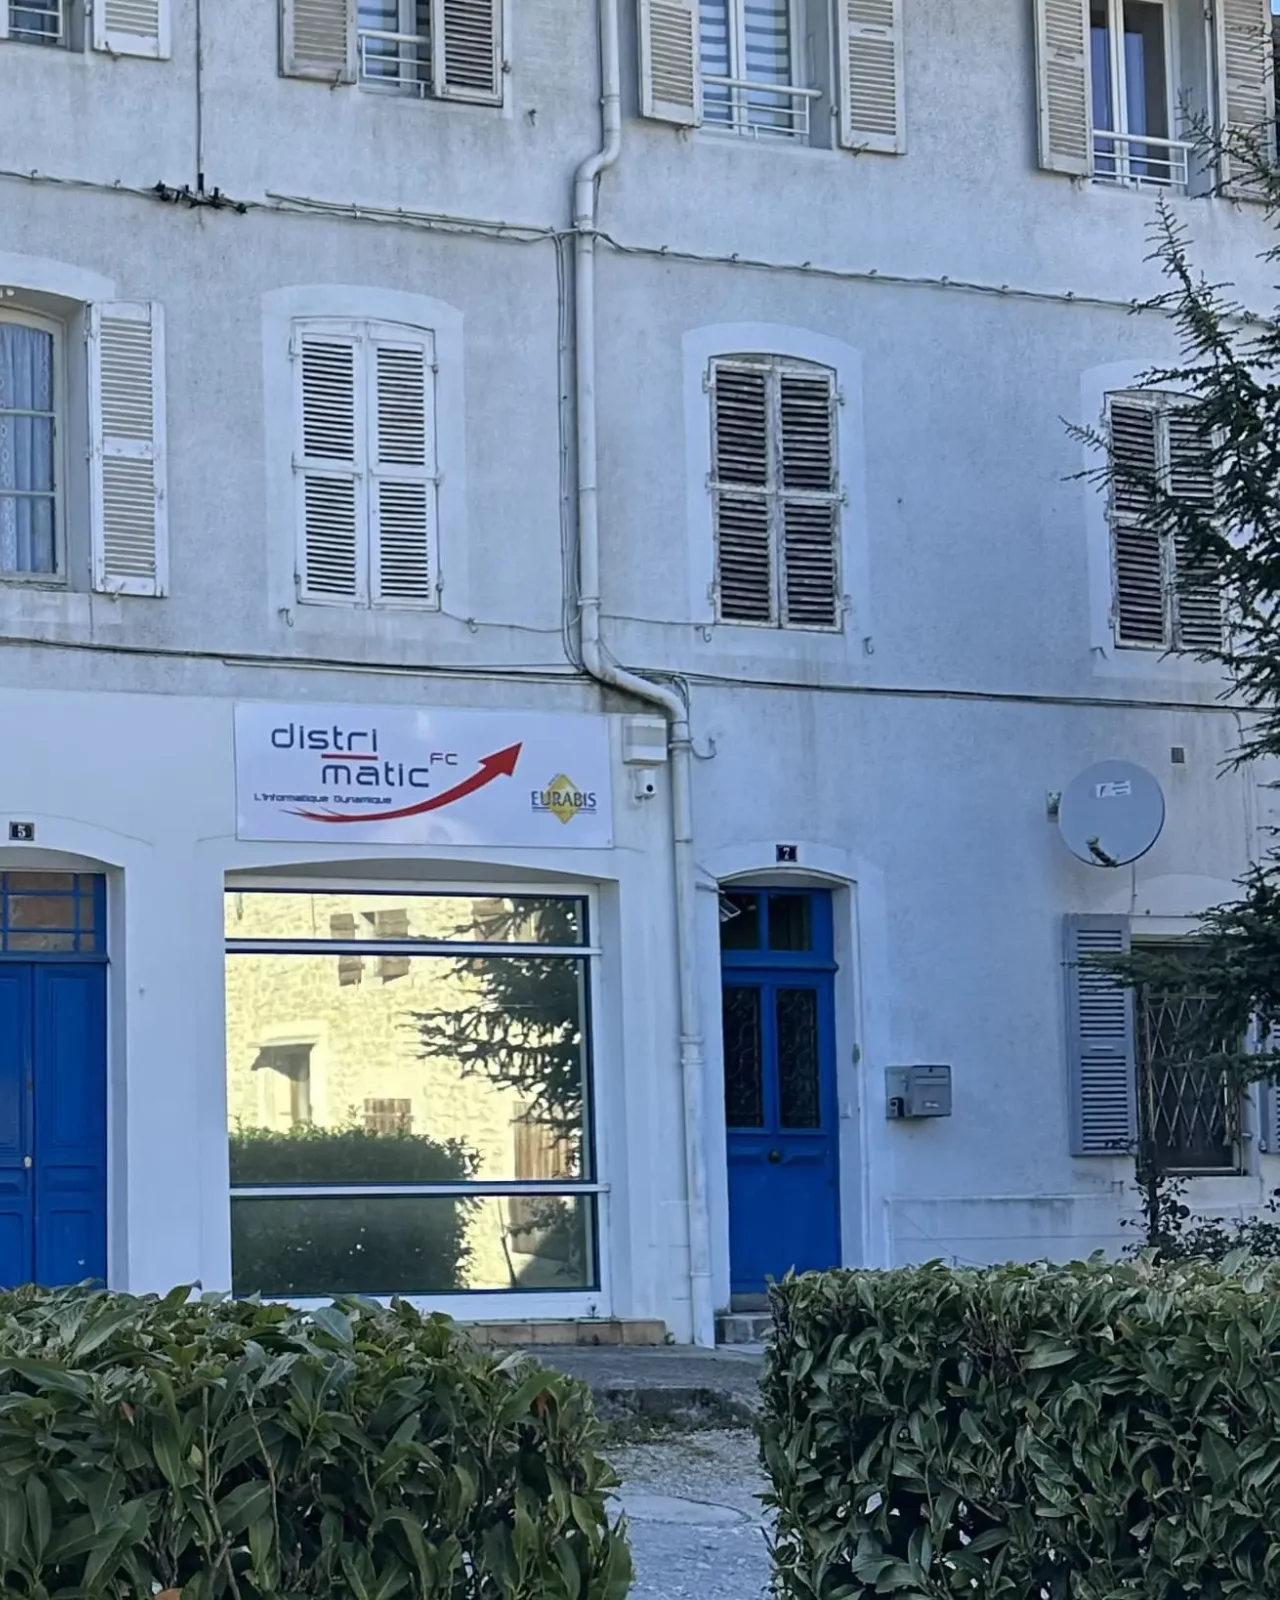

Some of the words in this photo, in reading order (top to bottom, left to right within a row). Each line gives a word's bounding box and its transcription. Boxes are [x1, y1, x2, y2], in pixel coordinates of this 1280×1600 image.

[271, 722, 378, 752] distri
[322, 761, 429, 788] matic
[430, 752, 458, 766] FC
[531, 790, 597, 808] EURABIS
[17, 825, 26, 838] 5
[782, 847, 790, 860] 7
